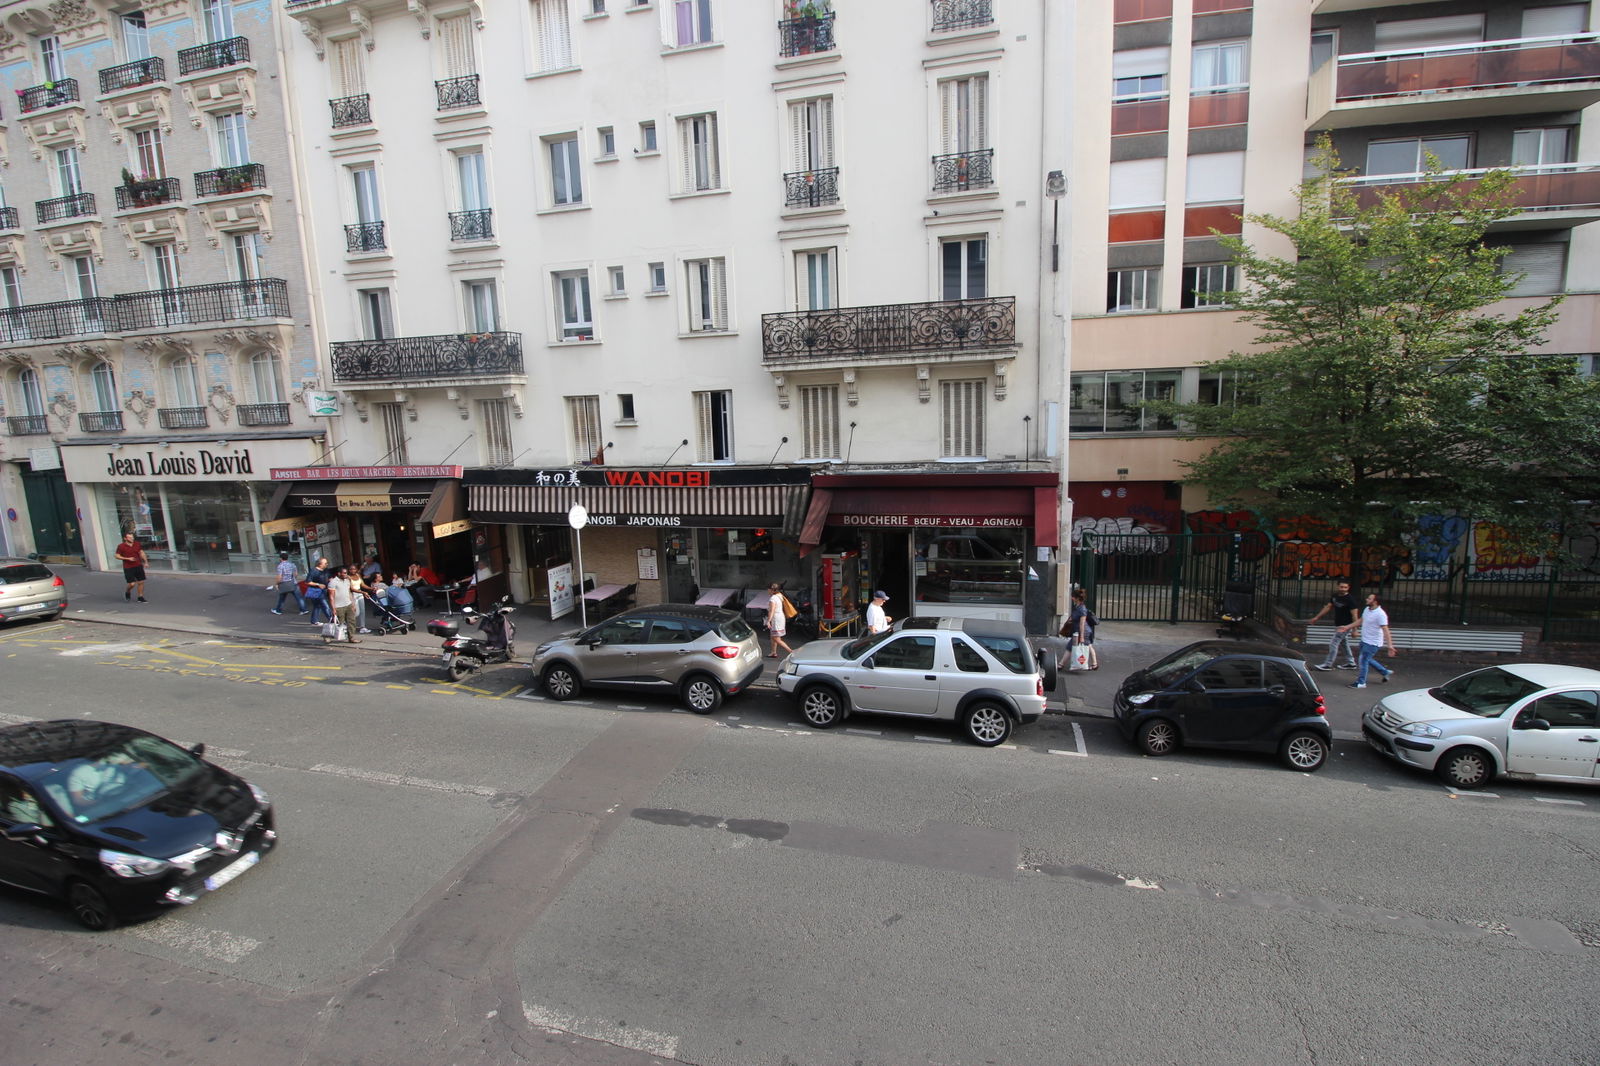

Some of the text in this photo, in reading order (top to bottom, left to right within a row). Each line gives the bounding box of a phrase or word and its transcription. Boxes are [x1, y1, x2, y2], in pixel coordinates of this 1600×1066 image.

[107, 449, 253, 476] Jean Louis David
[275, 470, 301, 479] AMSTEL
[306, 469, 321, 478] BAR
[327, 469, 340, 478] LES
[341, 468, 360, 477] DEUX
[403, 466, 451, 476] RESTAURANT
[535, 469, 581, 487] 和の美
[606, 471, 709, 487] WANOBI
[302, 497, 321, 506] Bistro
[398, 496, 430, 505] Restaura
[586, 516, 617, 525] ANOBI
[627, 516, 681, 526] JAPONAIS
[843, 515, 909, 525] BOUCHERIE
[914, 518, 941, 526] BŒUF
[949, 518, 974, 526] VEAU
[983, 518, 1023, 526] AGNEAU
